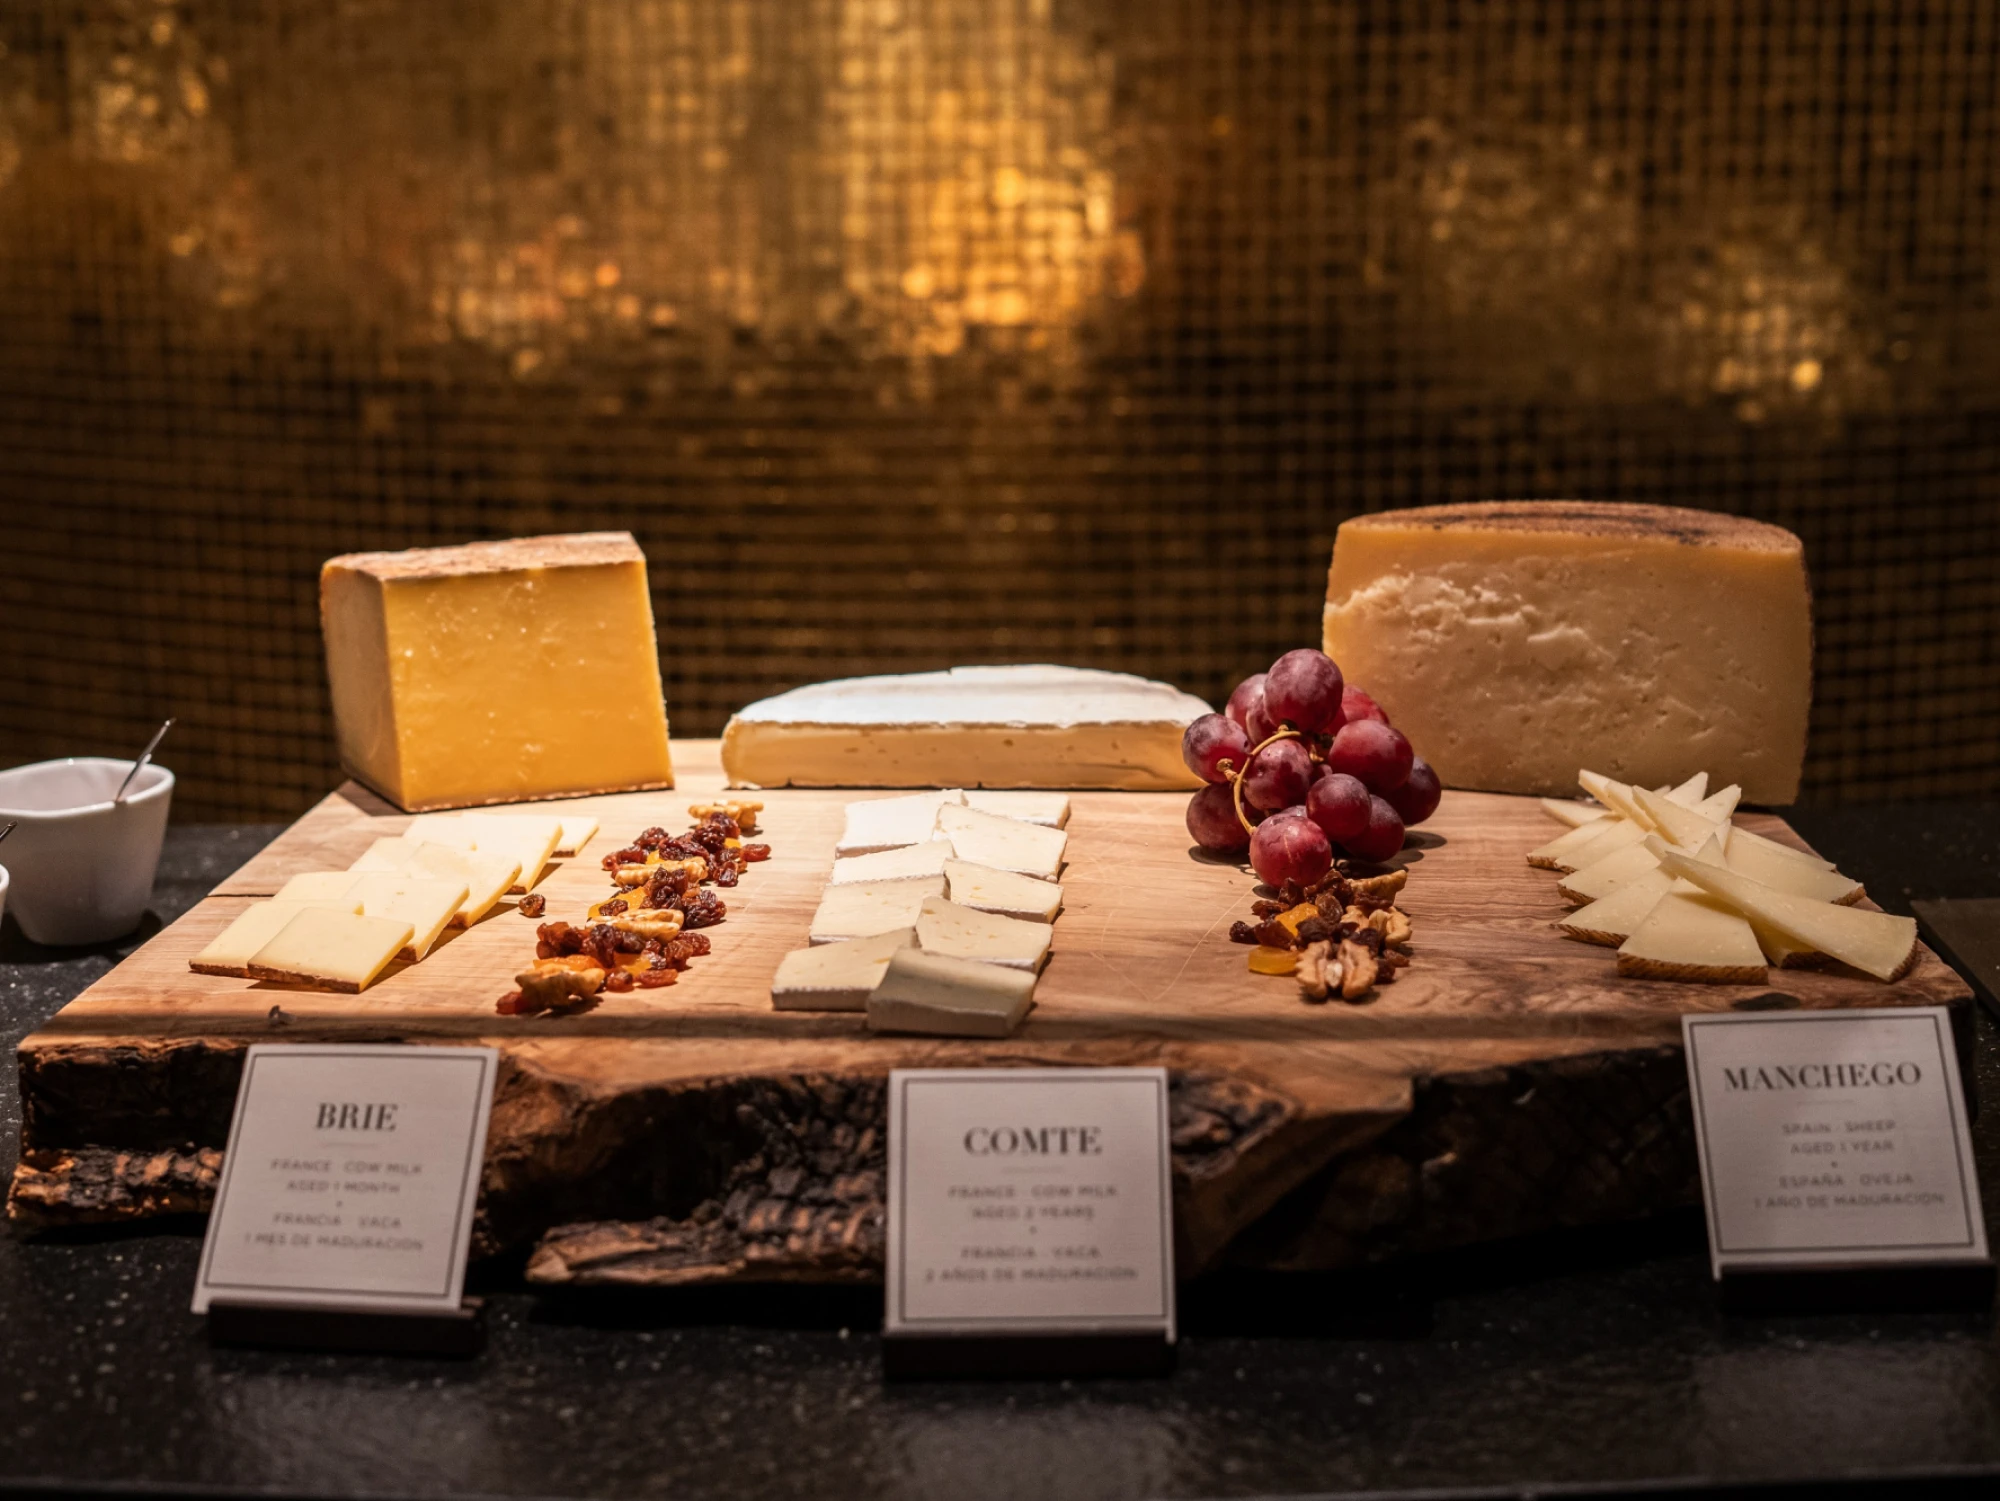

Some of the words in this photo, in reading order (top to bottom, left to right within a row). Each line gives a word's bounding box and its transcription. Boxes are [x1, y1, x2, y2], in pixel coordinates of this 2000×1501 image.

[1723, 1062, 1921, 1092] MANCHEGO
[315, 1102, 398, 1132] BRIE
[1782, 1122, 1831, 1134] SPAIN
[1845, 1119, 1896, 1133] SHEEP
[963, 1126, 1102, 1155] COMTE
[1790, 1142, 1834, 1154] AGED
[1851, 1140, 1894, 1152] YEAR
[271, 1159, 331, 1172] FRANCE
[343, 1162, 380, 1173] COW
[386, 1163, 422, 1175] MILK
[1859, 1173, 1914, 1186] OVEJA
[287, 1181, 329, 1192] AGED
[343, 1182, 400, 1193] MONTH
[948, 1185, 1016, 1198] FRANCE
[1030, 1185, 1073, 1197] COW
[1077, 1185, 1118, 1196] MILK
[1806, 1196, 1829, 1208] DE
[972, 1206, 1019, 1219] AGED
[273, 1213, 342, 1226] FRANCIA
[358, 1216, 401, 1228] VACA
[290, 1234, 312, 1245] DE
[961, 1246, 1035, 1259] FRANCIA
[1052, 1246, 1101, 1258] VACA
[992, 1268, 1014, 1280] DE
